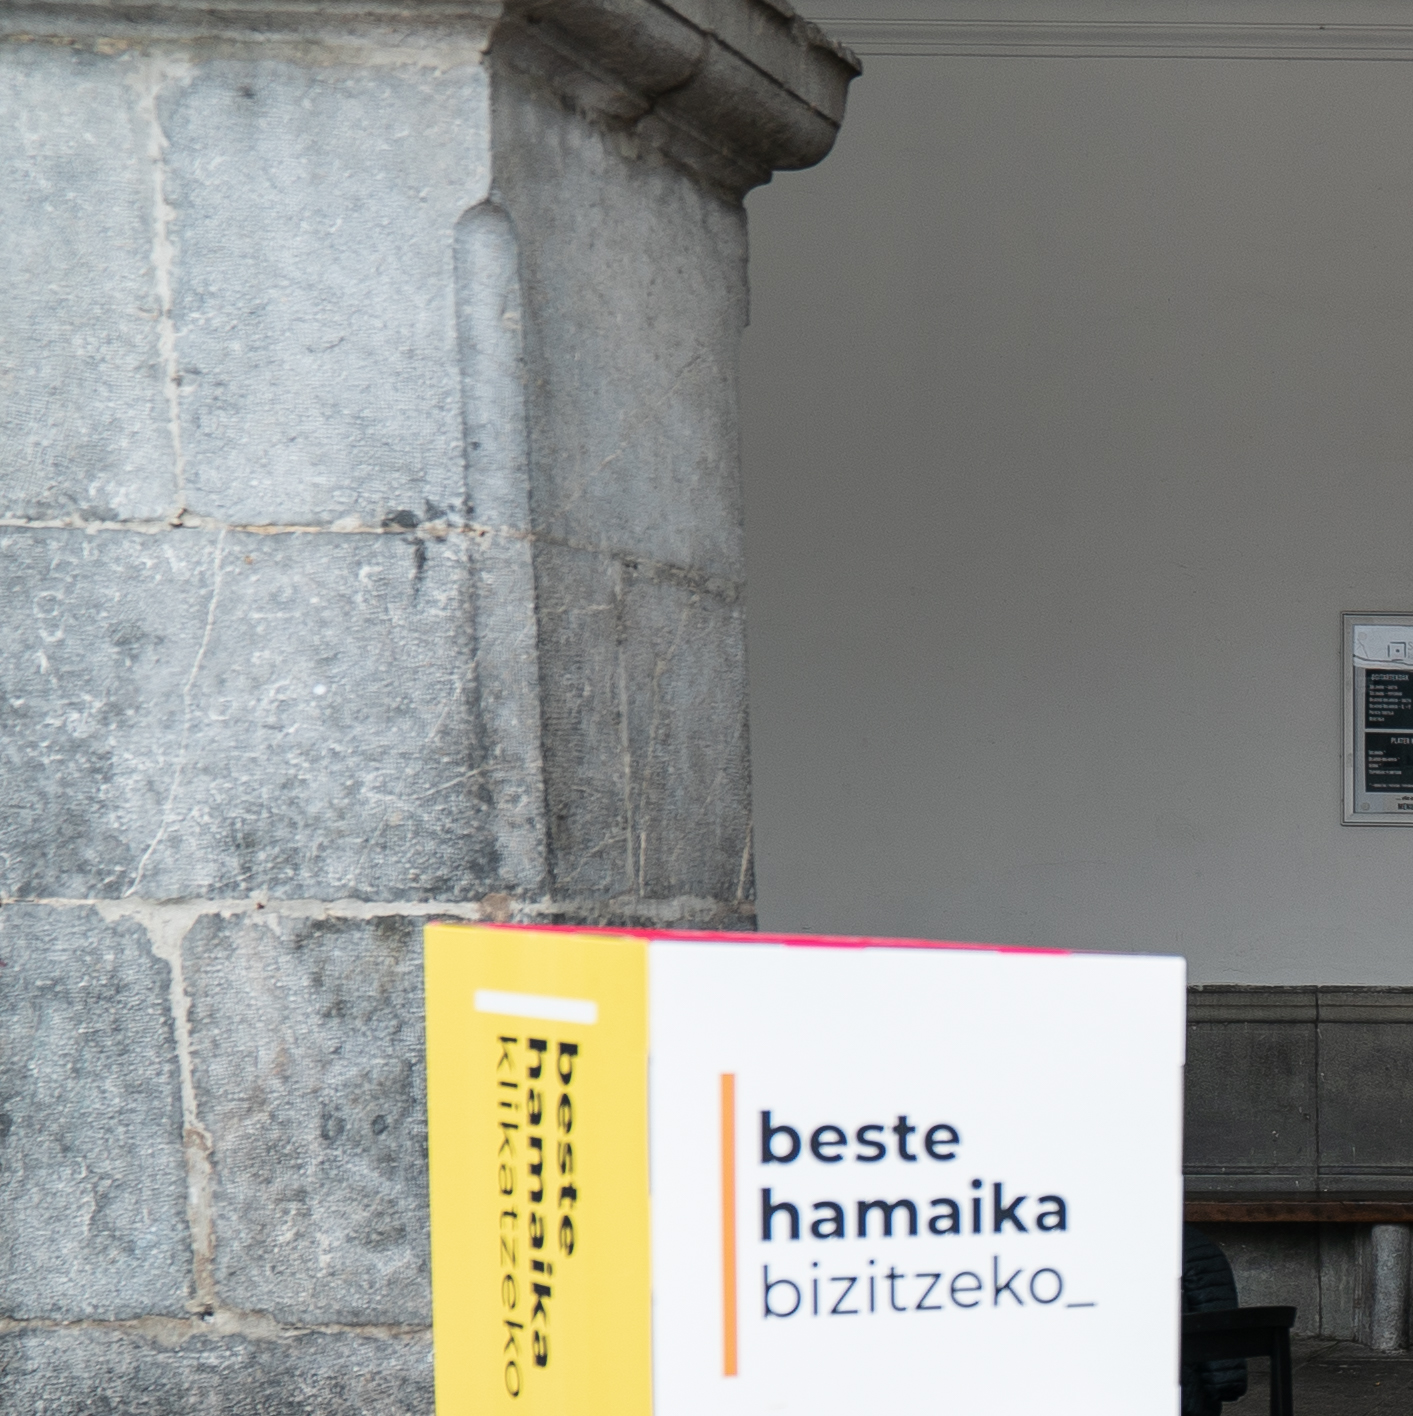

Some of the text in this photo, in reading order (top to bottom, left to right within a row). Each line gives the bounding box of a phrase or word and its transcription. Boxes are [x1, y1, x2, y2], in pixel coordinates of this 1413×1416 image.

[496, 1034, 524, 1400] klikatzeko
[526, 1036, 552, 1369] hamaika
[556, 1039, 581, 1256] beste
[759, 1110, 962, 1164] beste
[760, 1179, 1069, 1241] hamaika
